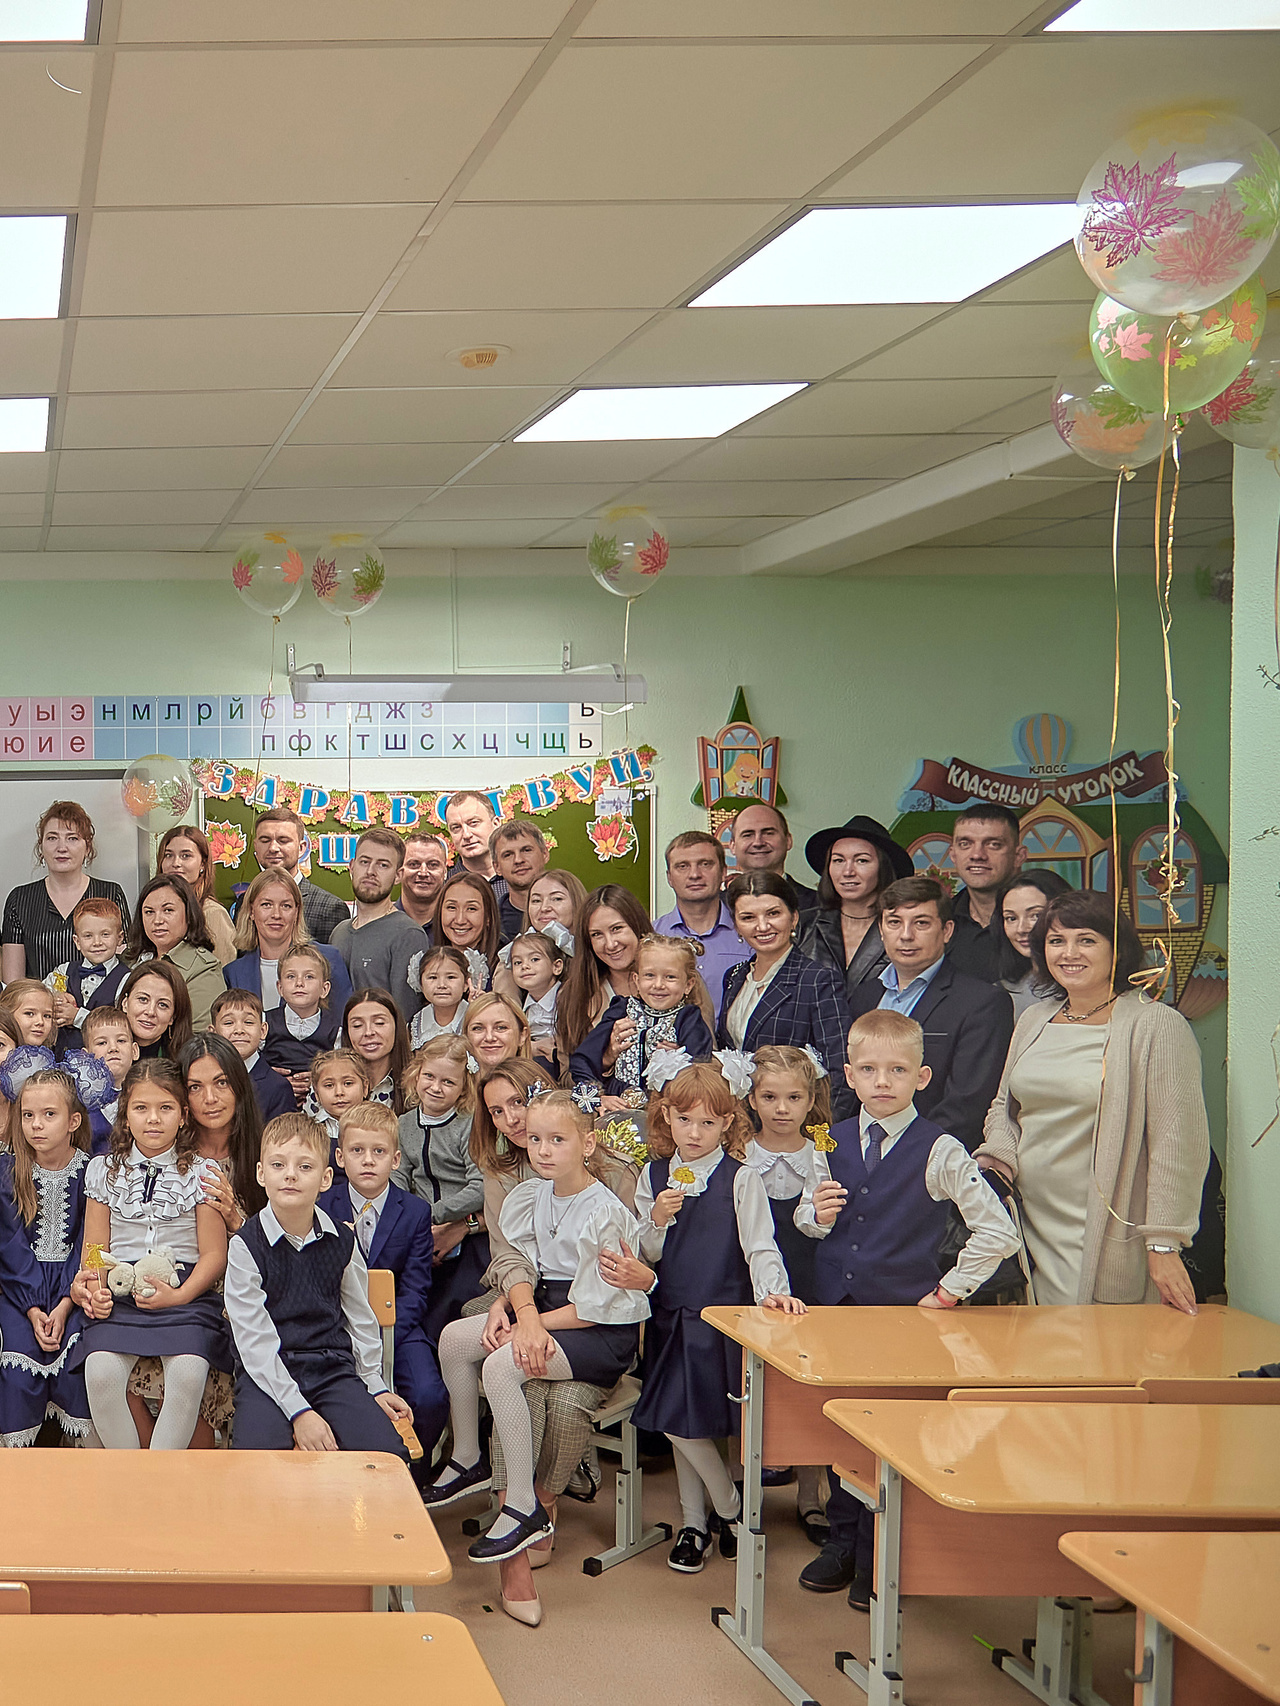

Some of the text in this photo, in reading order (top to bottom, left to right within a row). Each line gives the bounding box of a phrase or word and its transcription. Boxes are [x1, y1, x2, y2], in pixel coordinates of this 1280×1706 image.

[8, 704, 22, 726] у
[35, 703, 56, 721] ы
[70, 703, 86, 721] э
[102, 703, 117, 721] н
[132, 703, 151, 720] м
[164, 703, 182, 720] л
[197, 702, 212, 725] р
[228, 697, 244, 719] й
[4, 735, 25, 754] ю
[38, 735, 54, 753] и
[70, 734, 86, 753] е
[261, 734, 275, 751] п
[288, 729, 311, 756] ф
[325, 734, 338, 751] к
[356, 734, 370, 751] т
[385, 734, 407, 751] ш
[420, 733, 434, 751] с
[452, 733, 467, 750] х
[483, 733, 499, 754] ц
[515, 733, 530, 749] ч
[543, 732, 566, 753] щ
[579, 733, 593, 749] ь
[947, 758, 1145, 804] КЛАССНЫЙ УГОЛОК
[1029, 763, 1068, 775] класс
